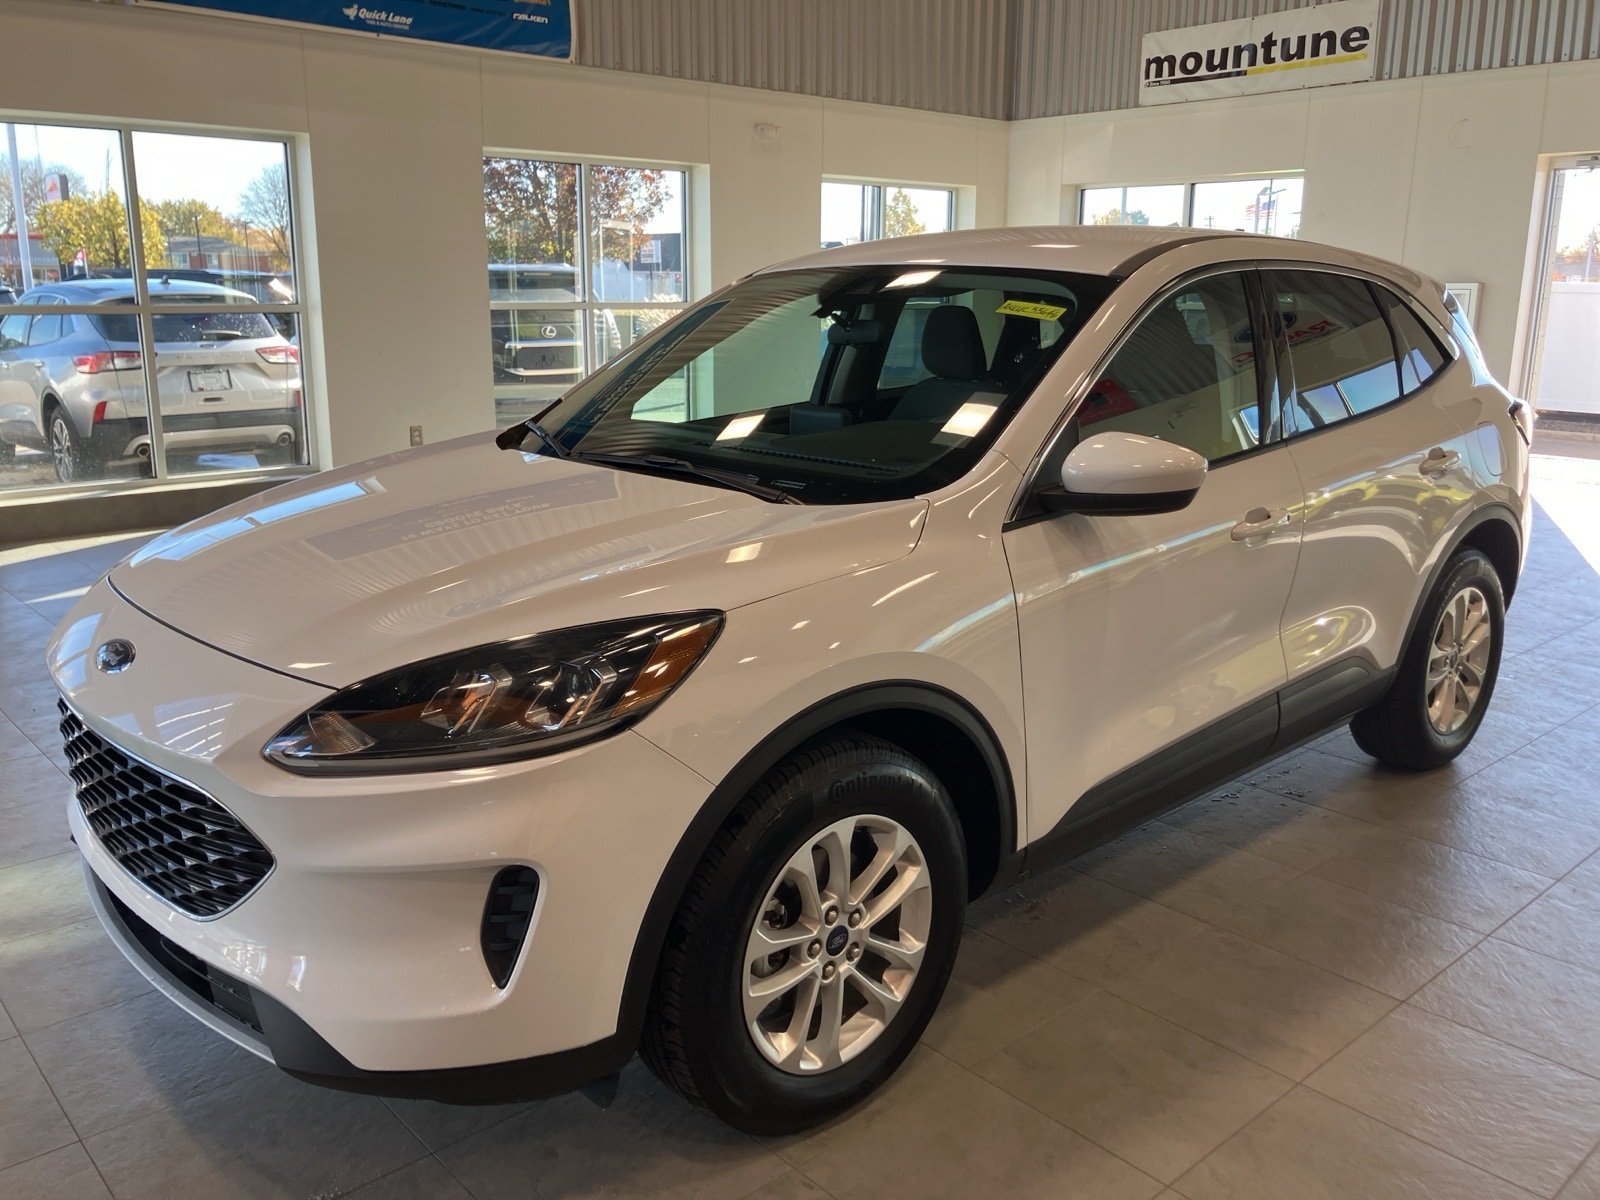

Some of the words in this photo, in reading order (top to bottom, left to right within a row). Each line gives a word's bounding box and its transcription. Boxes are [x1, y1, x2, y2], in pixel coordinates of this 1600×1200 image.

[358, 8, 387, 20] Quick
[388, 12, 413, 25] Lane
[513, 13, 548, 24] FALKEN
[1144, 26, 1370, 80] mountune
